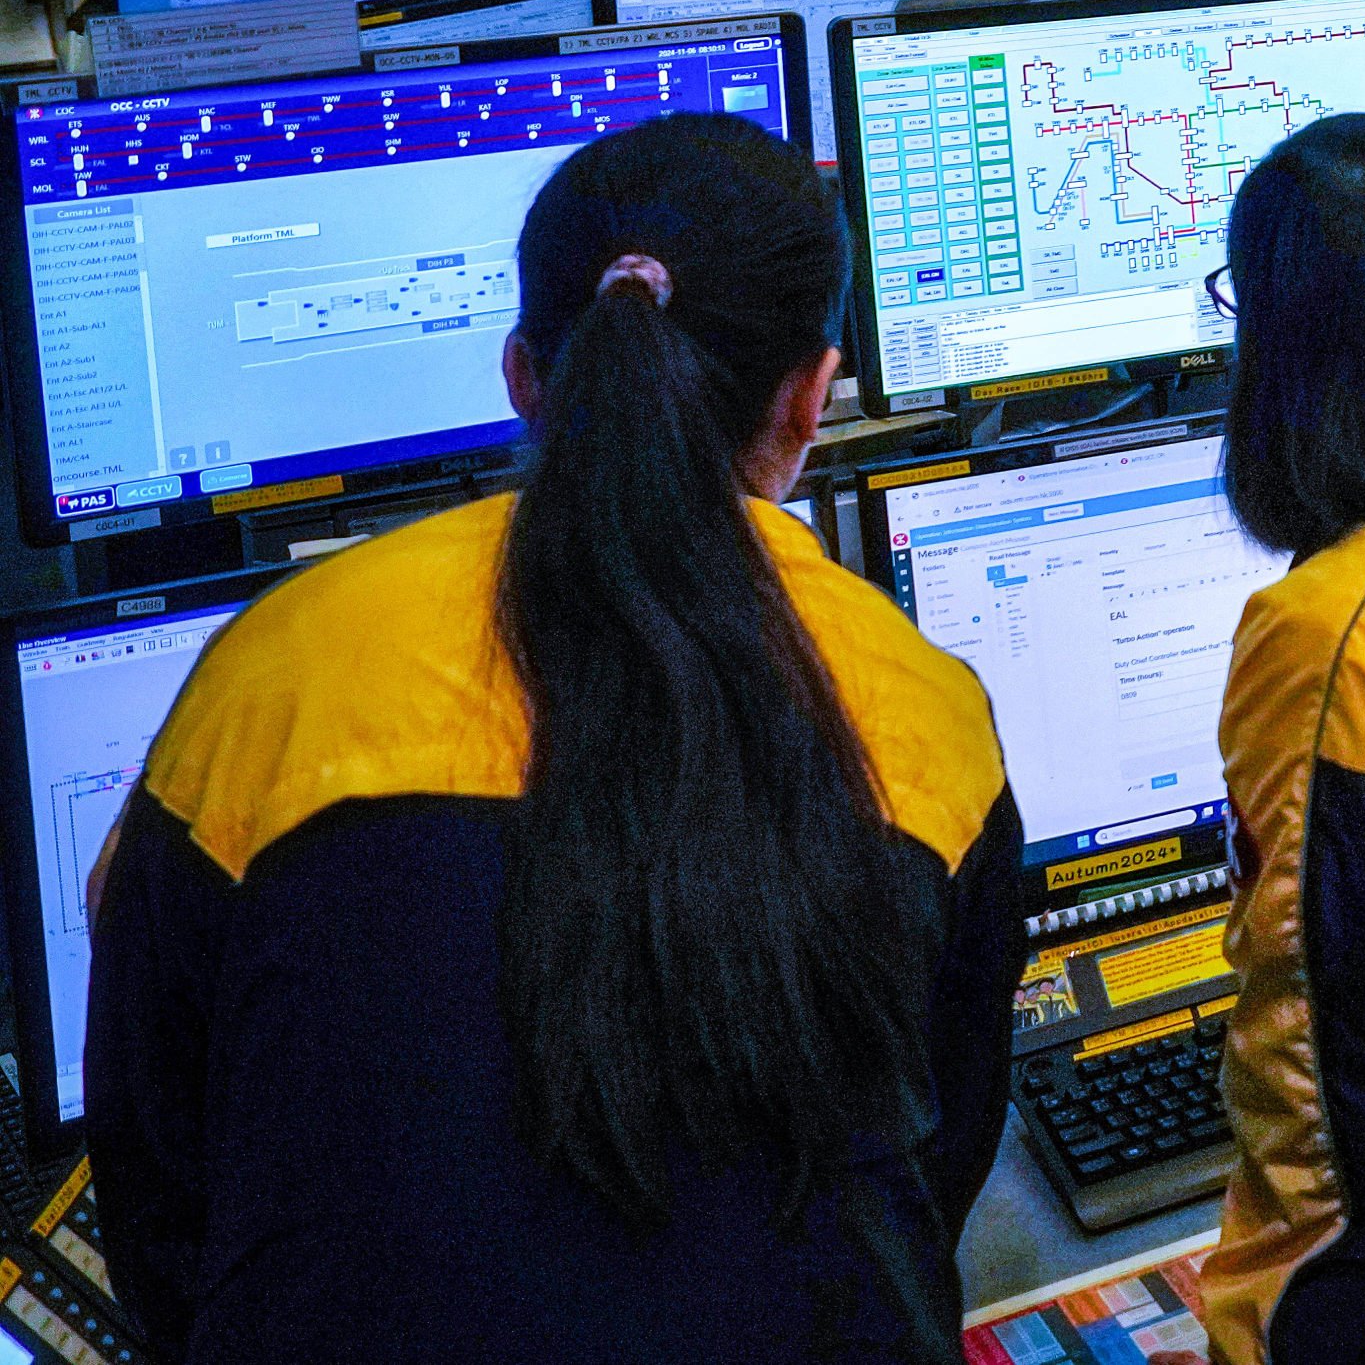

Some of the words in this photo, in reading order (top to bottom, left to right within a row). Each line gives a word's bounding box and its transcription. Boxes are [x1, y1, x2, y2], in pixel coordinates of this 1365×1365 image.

[658, 62, 672, 70] TUM
[381, 90, 395, 98] KSR
[322, 95, 340, 103] TWW
[111, 102, 133, 112] OCC
[142, 98, 170, 109] CCTV
[261, 101, 276, 109] MEF
[479, 103, 492, 111] KAT
[199, 108, 216, 116] NAC
[135, 114, 150, 122] AUS
[383, 113, 400, 121] SUW
[595, 115, 610, 123] MOS
[68, 120, 82, 128] ETS
[283, 123, 300, 131] TKW
[527, 123, 542, 131] HEO
[180, 134, 199, 142] HOM
[457, 131, 470, 139] TSH
[28, 136, 49, 145] WRL
[125, 139, 142, 148] HHS
[385, 138, 401, 146] SHM
[71, 145, 89, 154] HUH
[30, 158, 47, 166] SCL
[234, 154, 251, 163] STW
[155, 163, 170, 171] CKT
[74, 171, 92, 179] TAW
[32, 184, 54, 193] MOL
[57, 208, 93, 219] Camera
[95, 205, 111, 214] List
[232, 231, 273, 244] Platform
[275, 229, 294, 238] TML
[56, 310, 67, 318] A1
[43, 344, 57, 352] Ent
[59, 342, 70, 350] A2
[45, 361, 59, 369] Ent
[61, 356, 96, 367] A2-Sub1
[1181, 352, 1216, 368] DELL
[46, 377, 61, 385] Ent
[62, 371, 98, 383] A2-Sub2
[81, 494, 106, 507] PAS
[139, 483, 173, 498] CCTV
[917, 546, 958, 559] Message
[1110, 611, 1128, 621] EAL
[1163, 624, 1195, 636] operation
